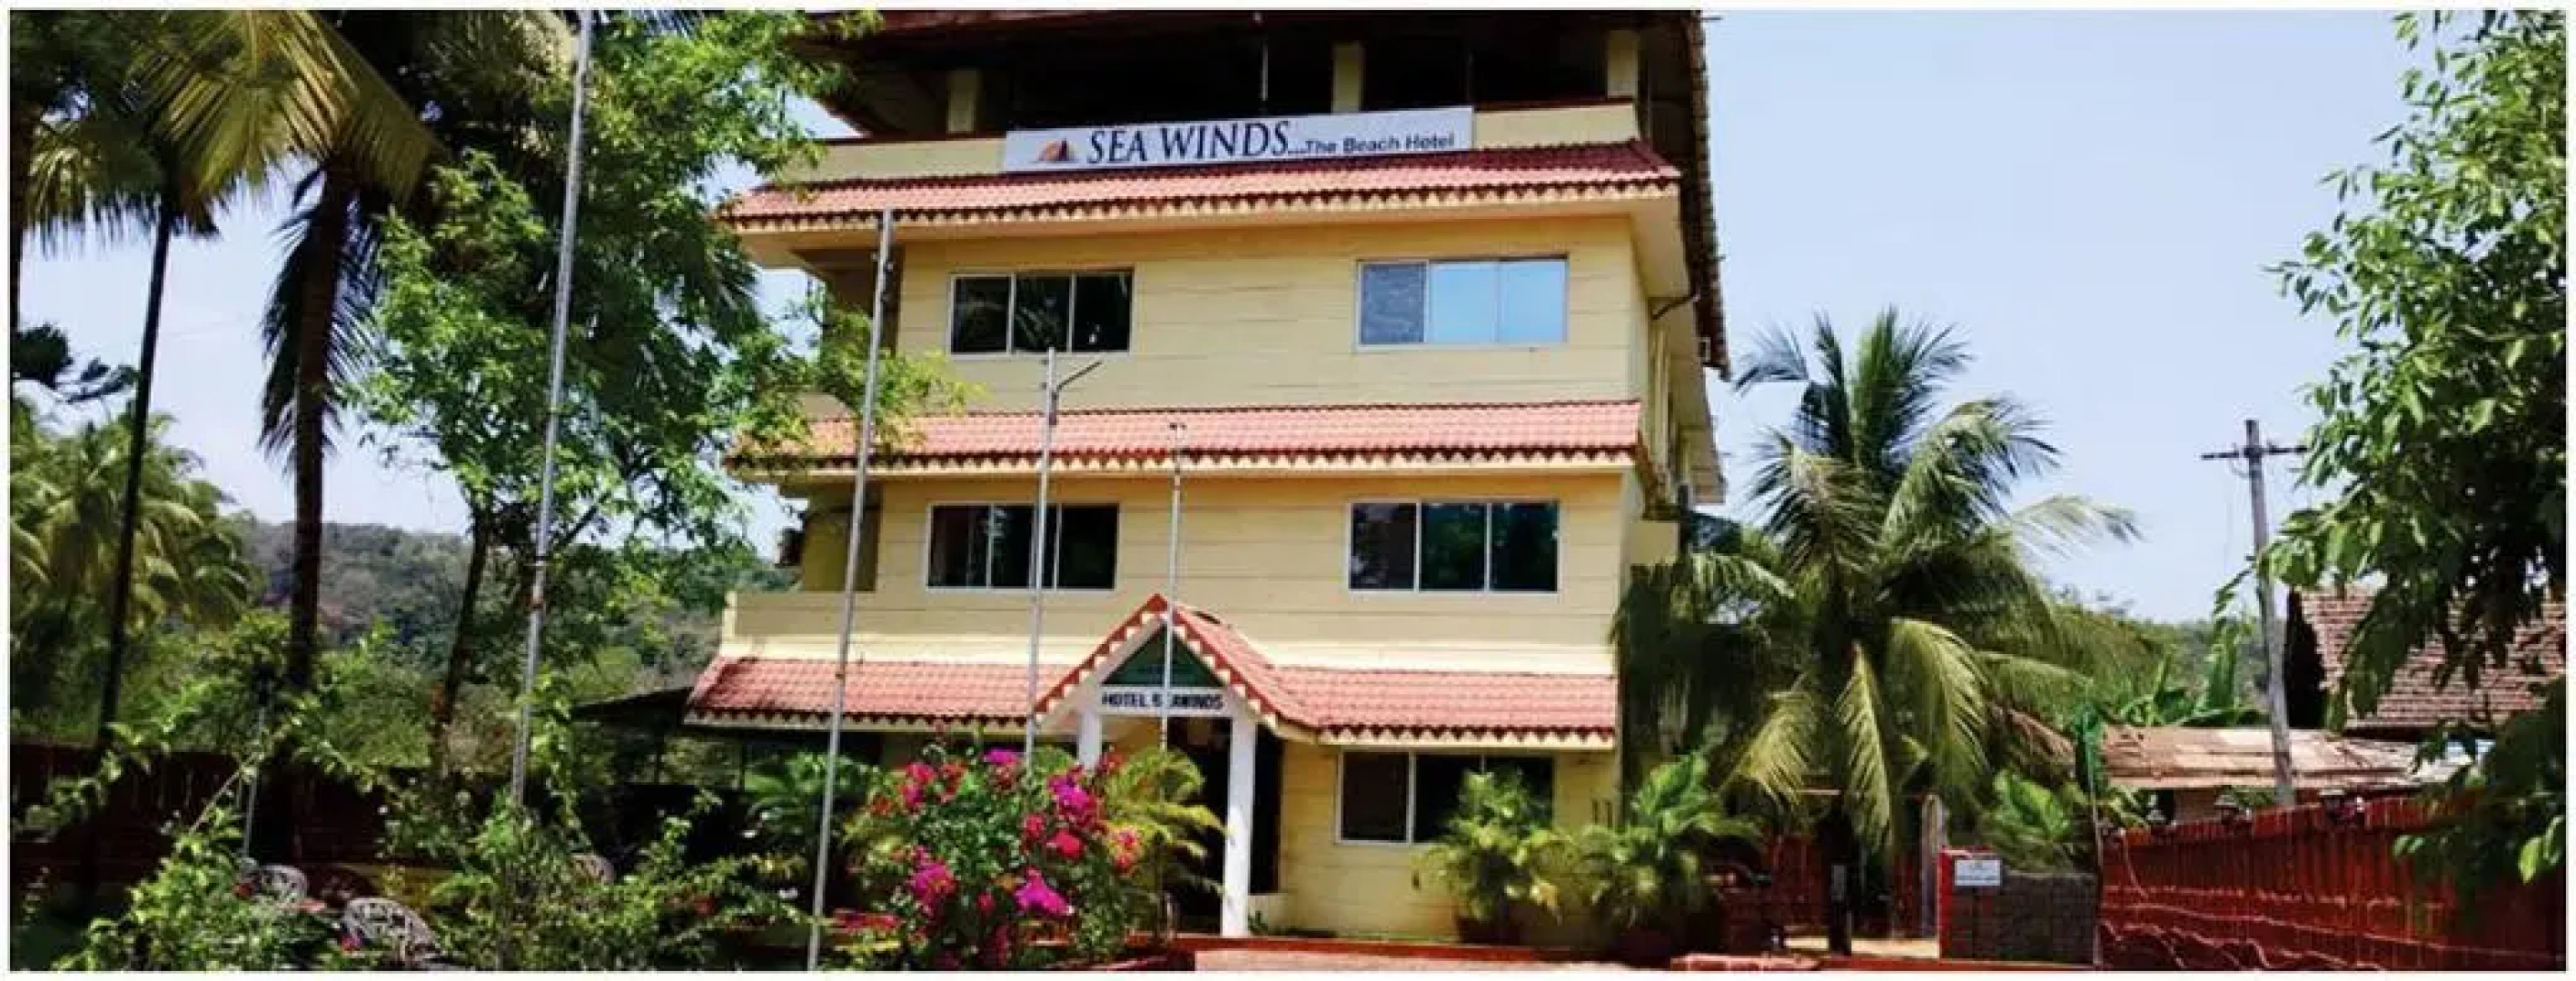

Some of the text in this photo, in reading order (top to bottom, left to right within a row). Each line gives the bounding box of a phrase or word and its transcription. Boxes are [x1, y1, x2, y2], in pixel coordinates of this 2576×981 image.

[1088, 130, 1147, 164] SEA
[1343, 135, 1400, 153] Beach
[1405, 132, 1455, 150] Hotel
[1101, 691, 1224, 710] HOTEL SAWINDS
